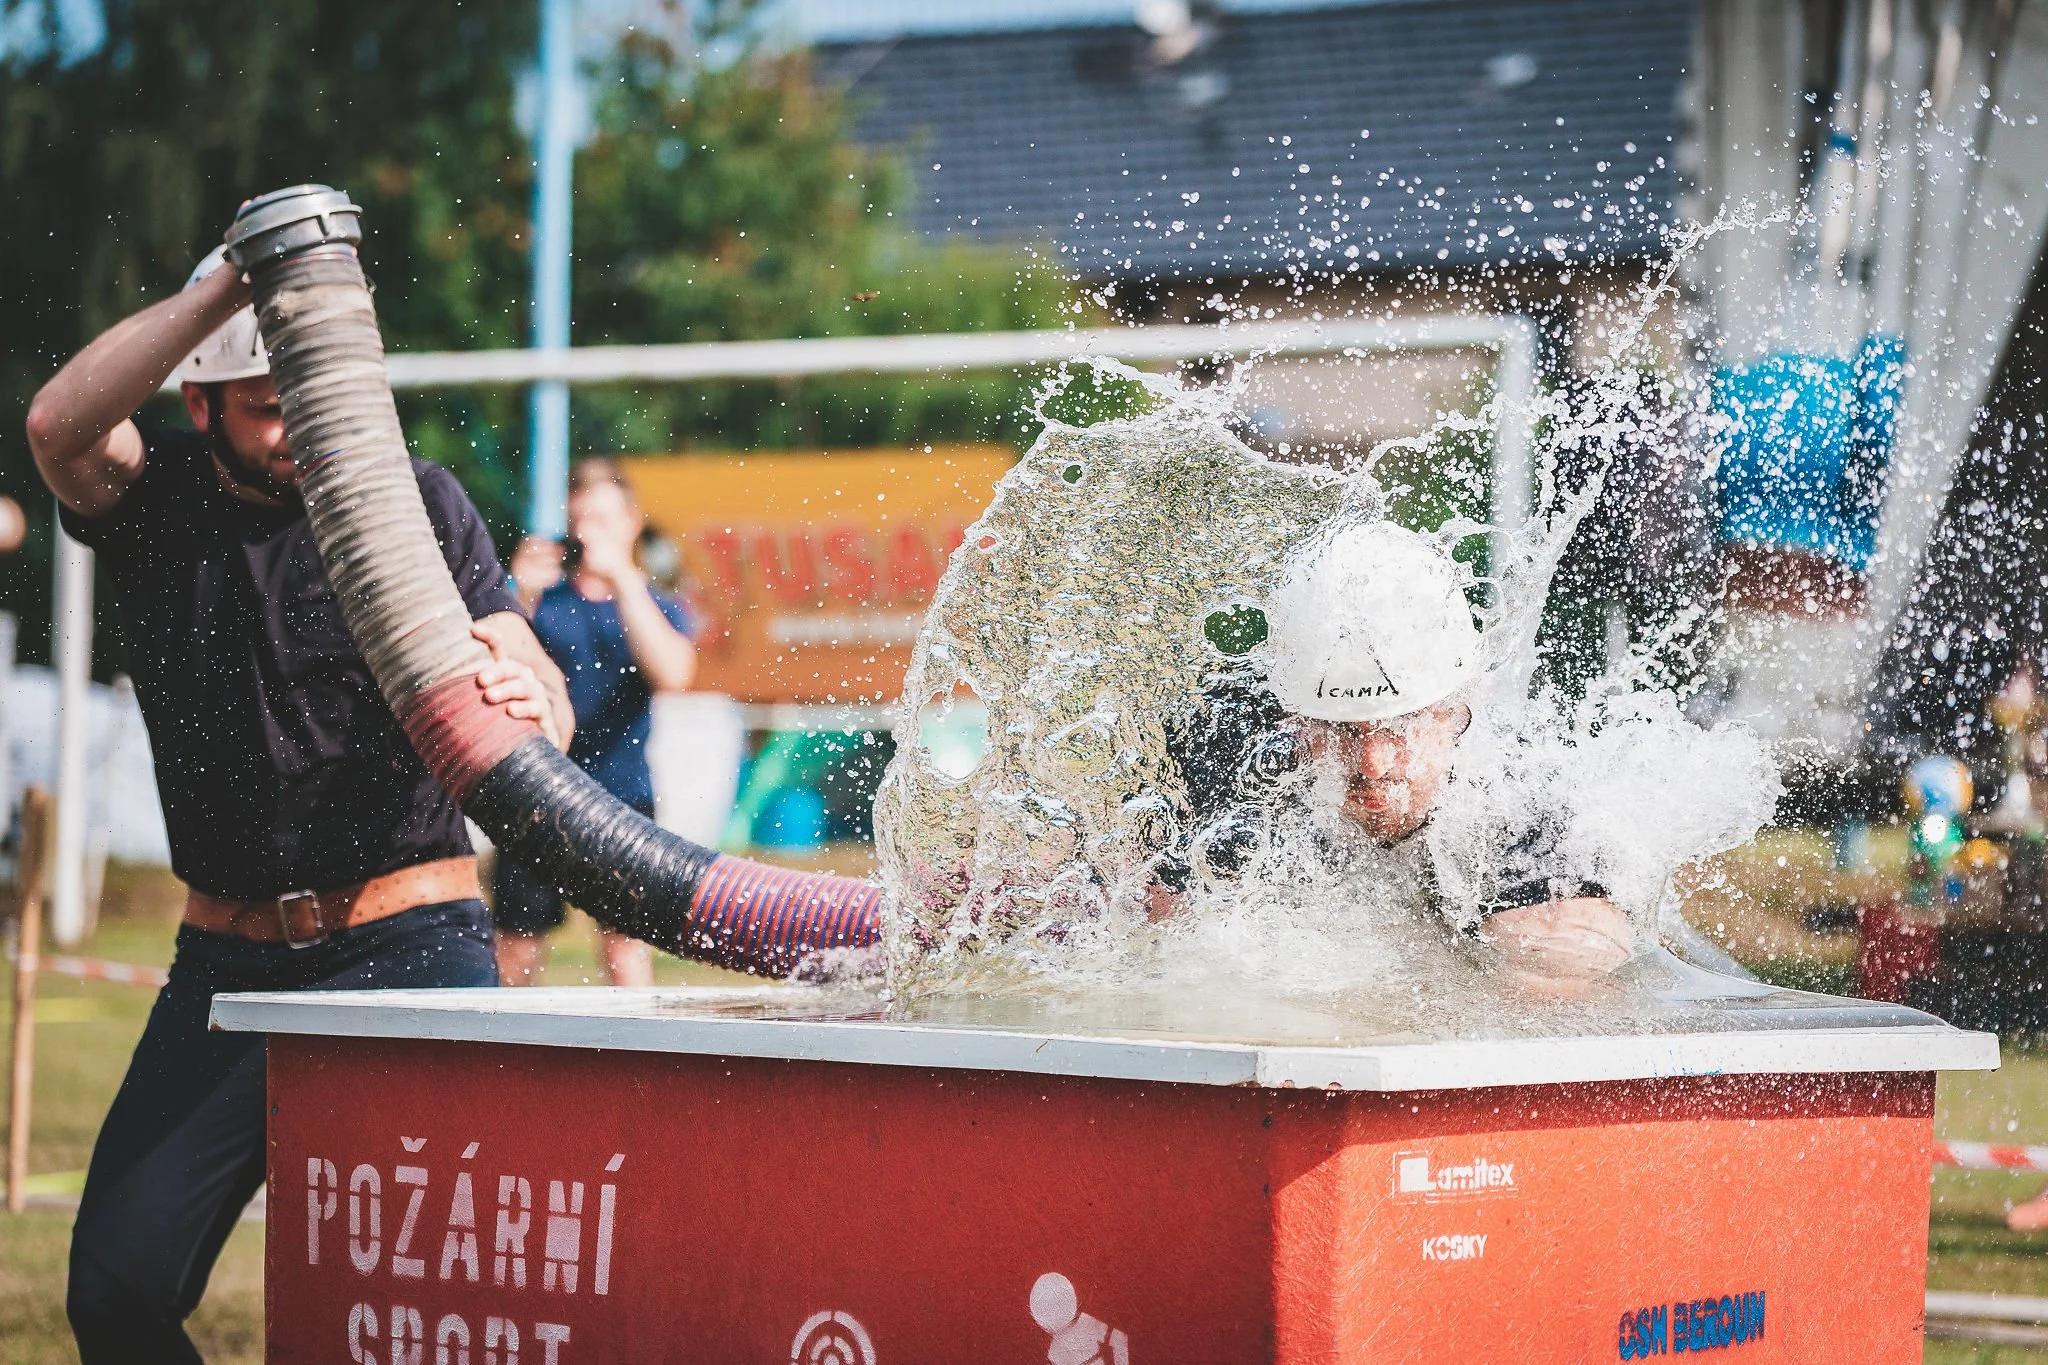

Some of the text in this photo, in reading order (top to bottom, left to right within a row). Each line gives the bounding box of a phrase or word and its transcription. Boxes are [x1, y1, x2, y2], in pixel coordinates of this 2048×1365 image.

[1328, 685, 1389, 698] CAMP
[1400, 1157, 1514, 1192] Lamitex
[307, 1136, 626, 1295] POŽÁRNÍ
[1422, 1233, 1488, 1261] KOSKY
[1673, 1290, 1766, 1353] BEROUN
